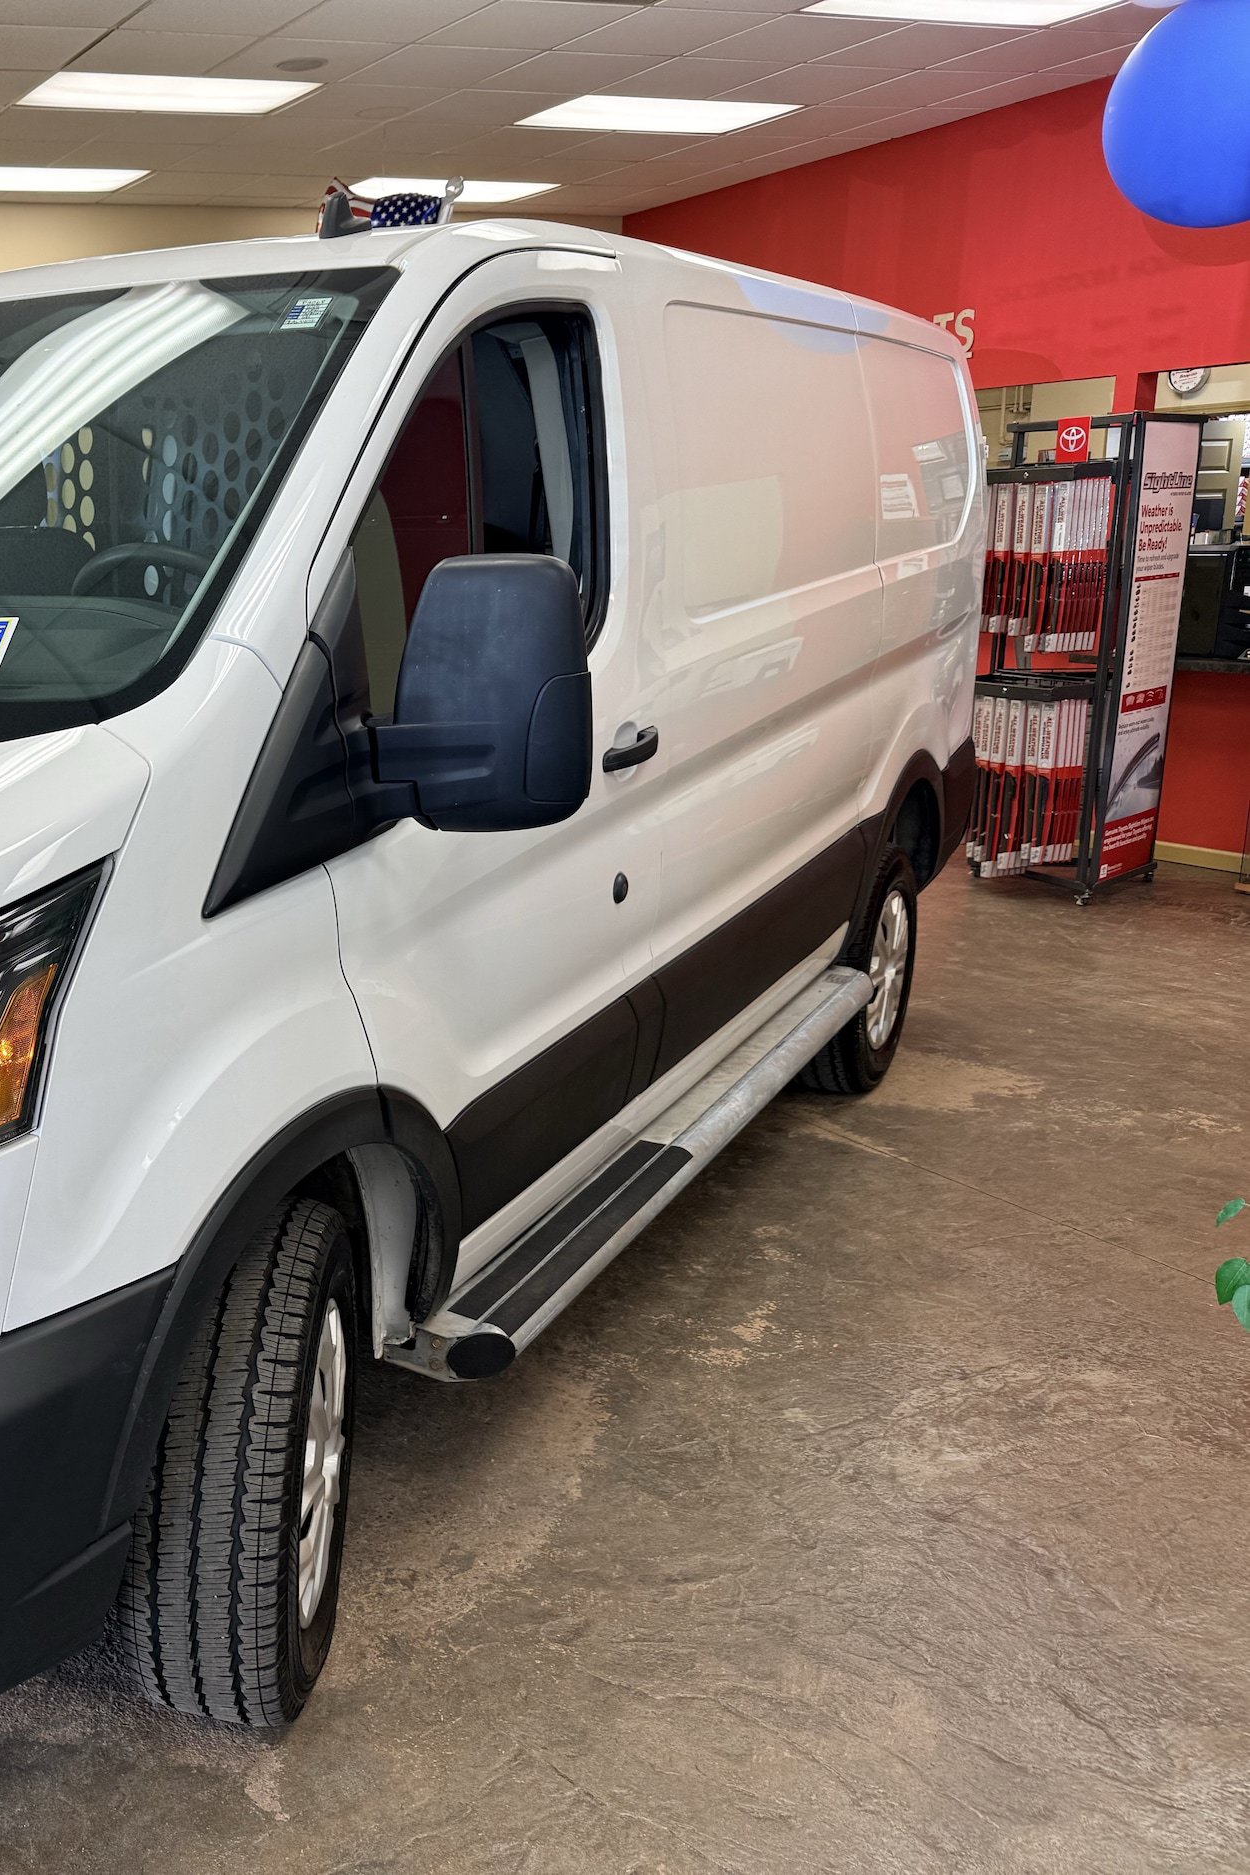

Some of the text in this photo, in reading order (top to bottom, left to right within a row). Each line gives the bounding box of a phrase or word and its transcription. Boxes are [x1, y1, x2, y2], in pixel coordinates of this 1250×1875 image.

[1143, 472, 1193, 494] SightLine
[1018, 500, 1026, 544] ALL-WEATHER
[1036, 500, 1045, 545] ALL-WEATHER
[1141, 502, 1174, 518] Weather is
[1140, 518, 1183, 537] Unpredictable.
[1138, 536, 1168, 552] Be Ready!
[1030, 714, 1038, 757] ALL-WEATHER
[1044, 716, 1052, 760] ALL-WEATHER
